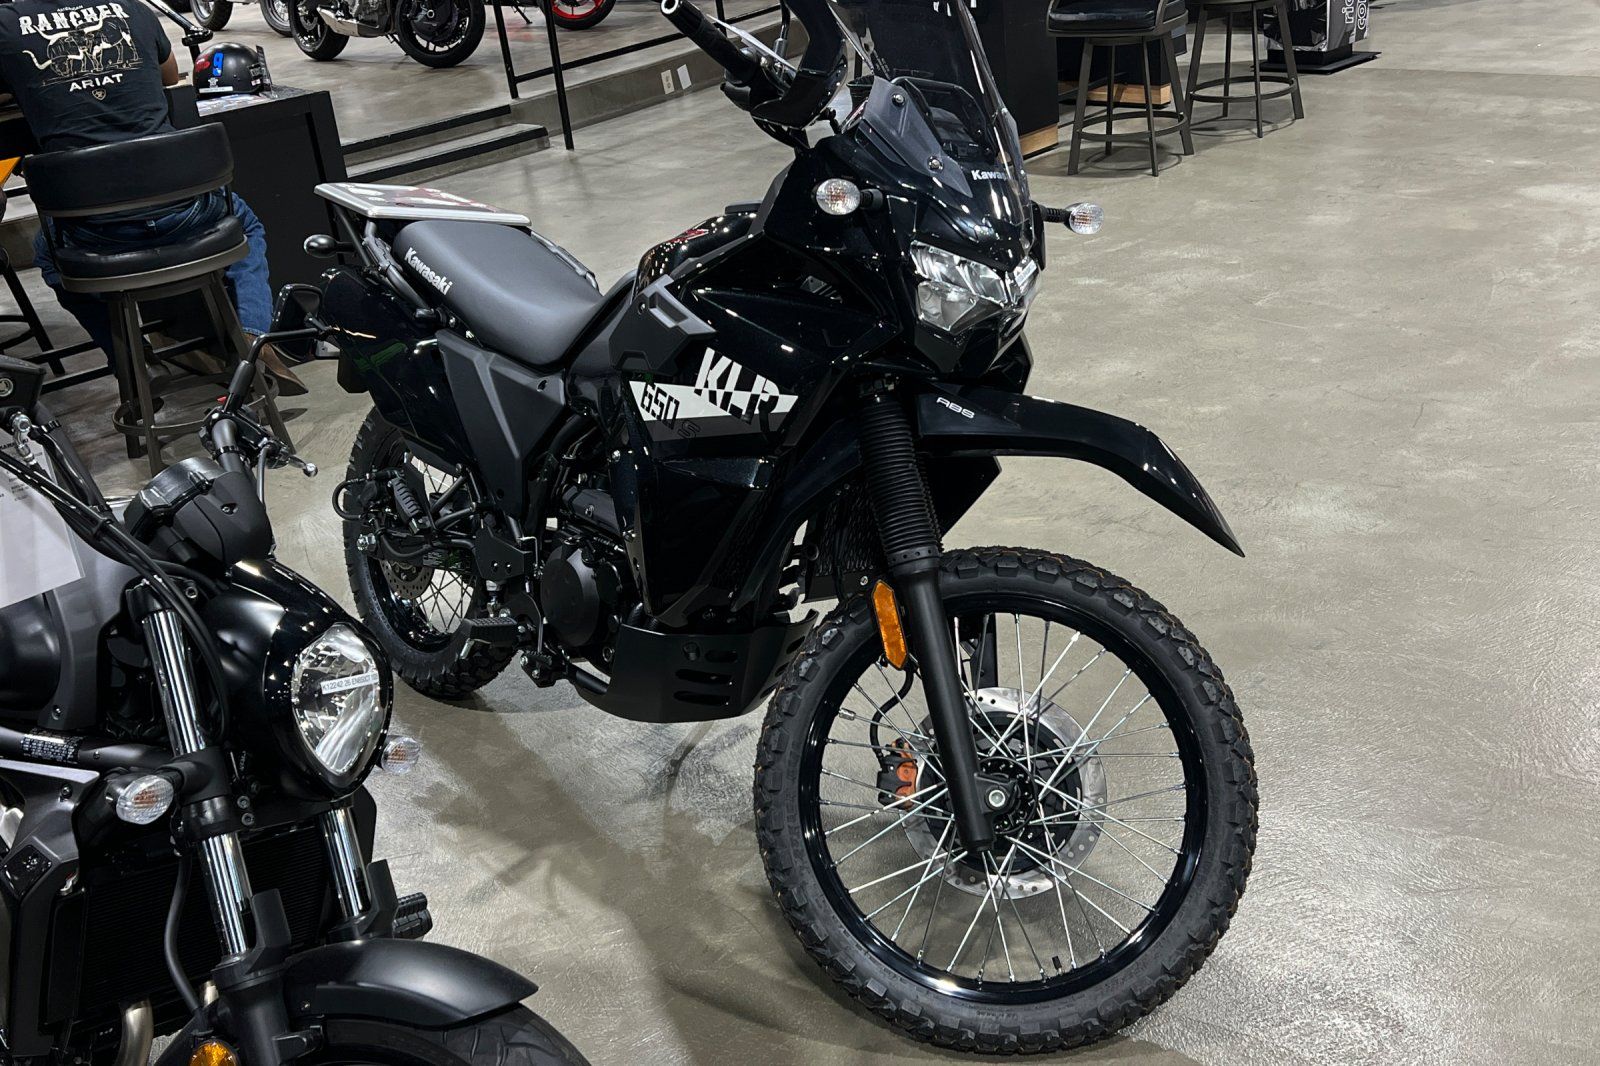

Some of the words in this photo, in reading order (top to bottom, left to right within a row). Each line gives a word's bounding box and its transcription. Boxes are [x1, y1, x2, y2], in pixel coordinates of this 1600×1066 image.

[18, 2, 130, 35] RANCHER
[1357, 0, 1366, 29] co
[69, 73, 123, 92] ARIAT
[404, 247, 453, 295] Kawasaki
[640, 382, 681, 430] 650
[693, 347, 780, 434] KLR
[936, 396, 975, 419] ABS
